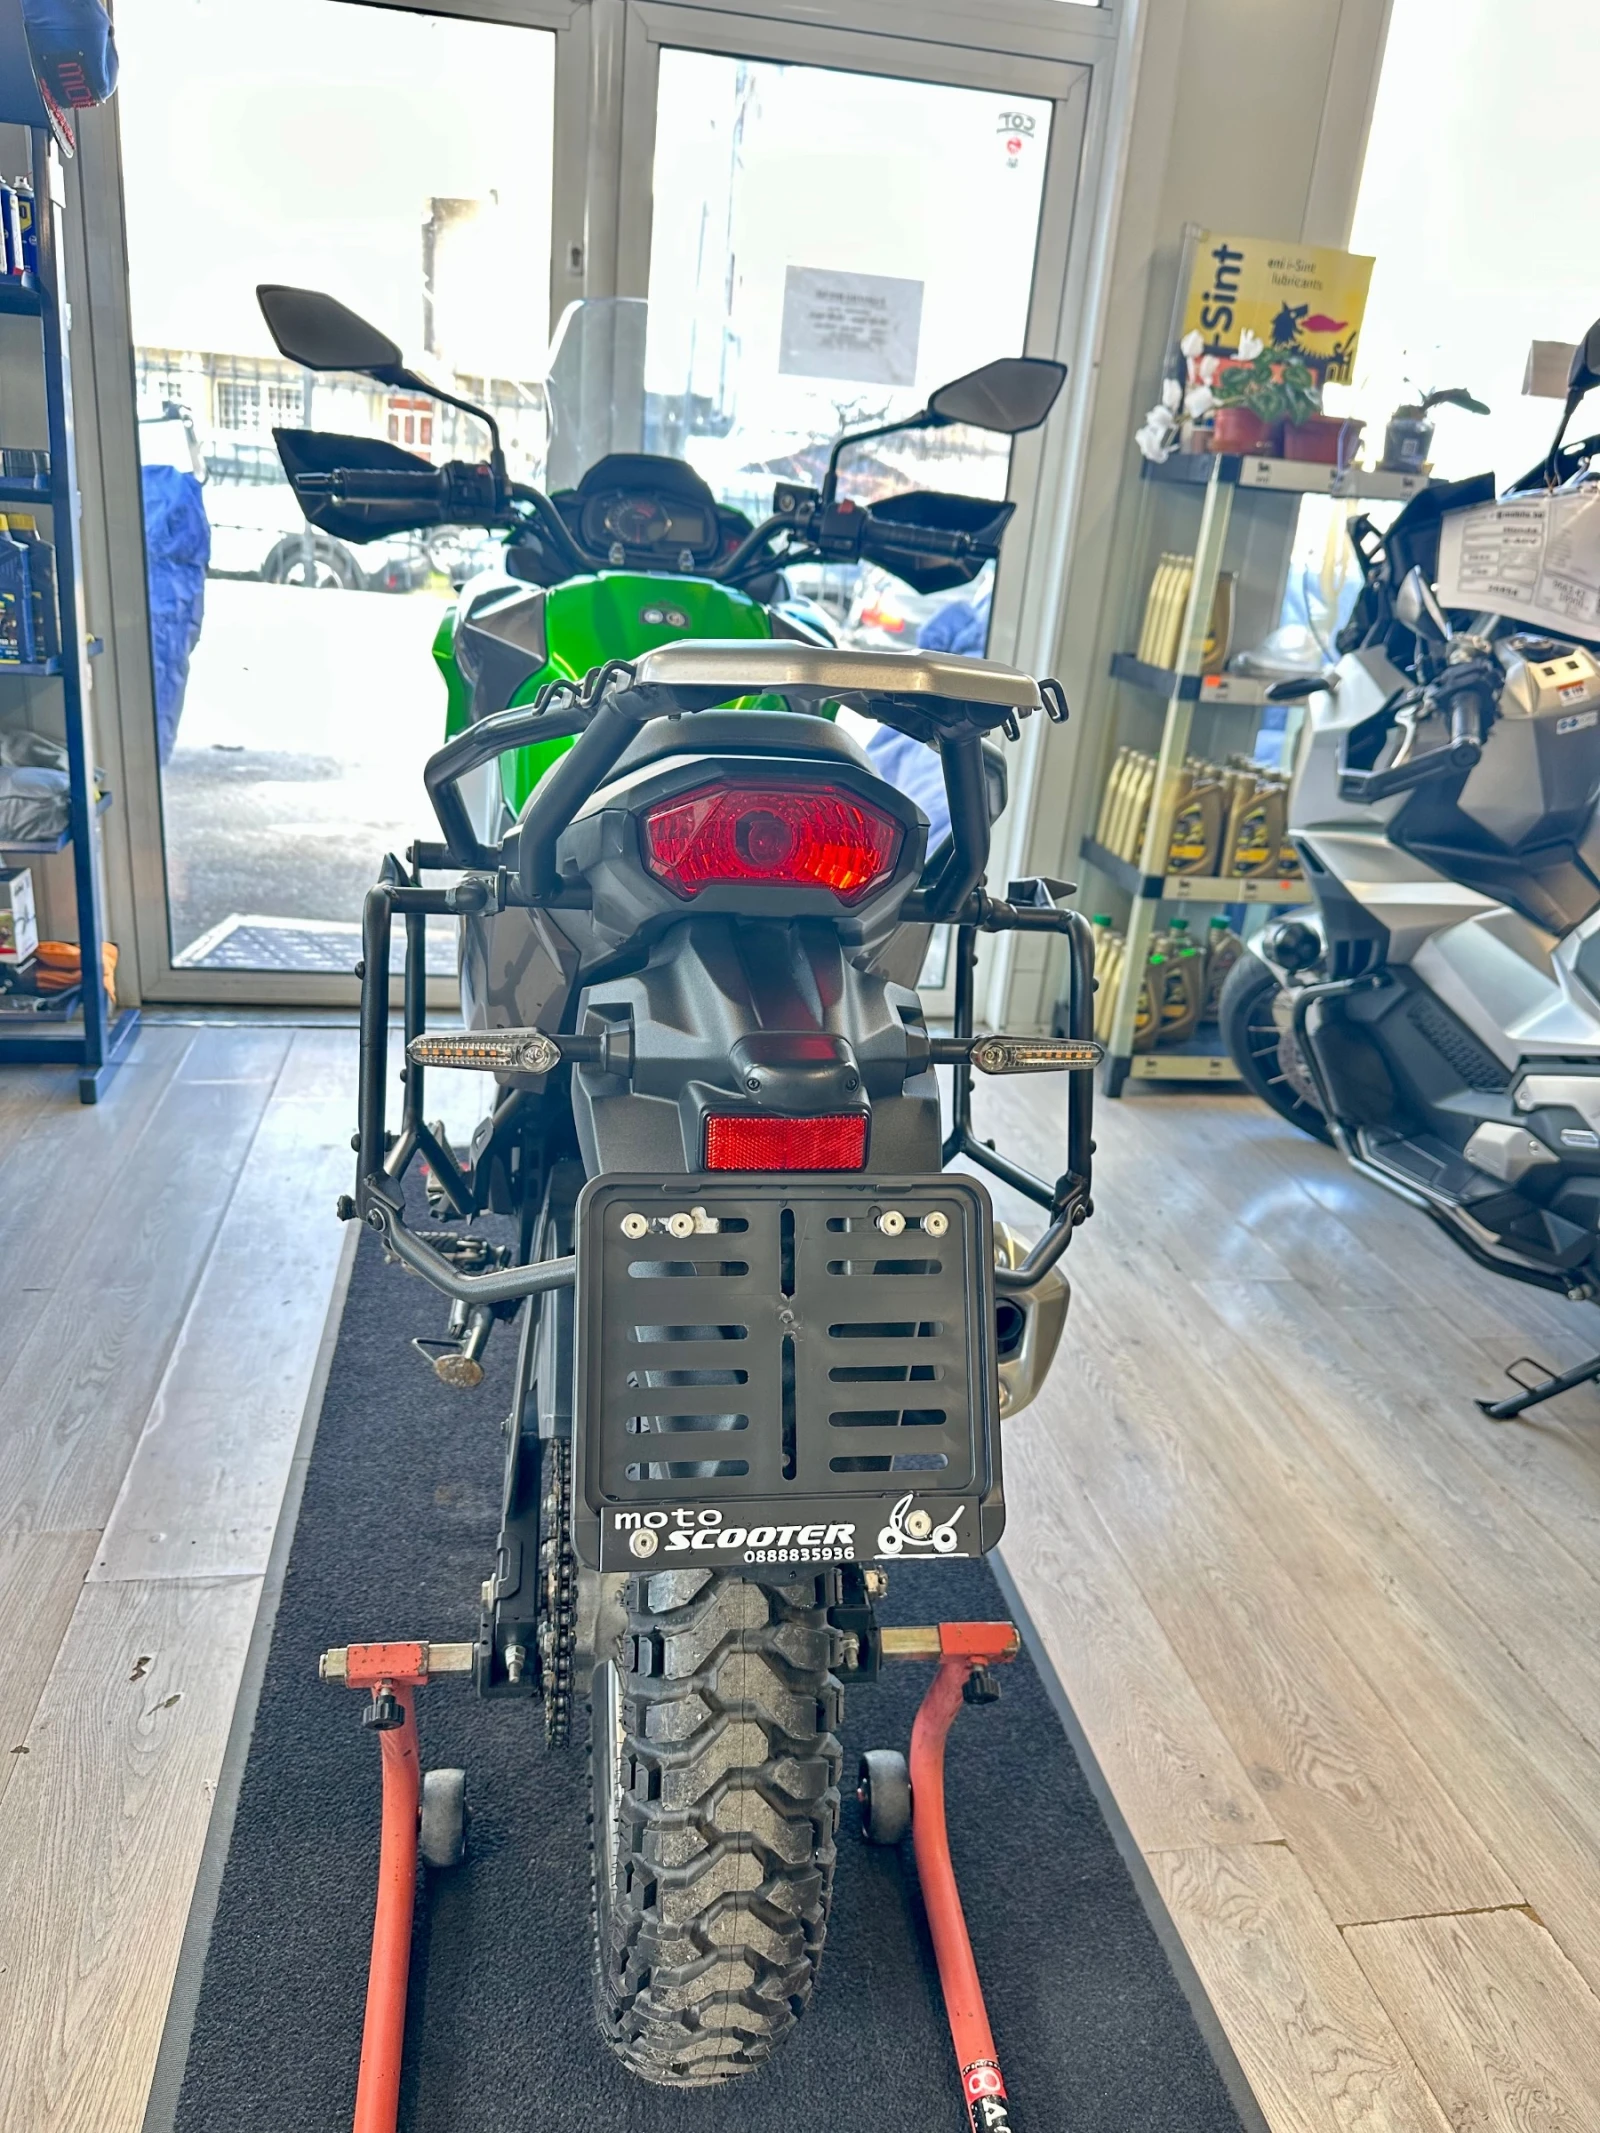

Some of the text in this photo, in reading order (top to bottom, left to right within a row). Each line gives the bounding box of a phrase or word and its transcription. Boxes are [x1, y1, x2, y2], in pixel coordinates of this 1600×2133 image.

[1271, 272, 1323, 291] lubricants
[614, 1508, 723, 1530] moto
[664, 1523, 856, 1551] SCOOTER
[743, 1546, 855, 1563] 0888835936
